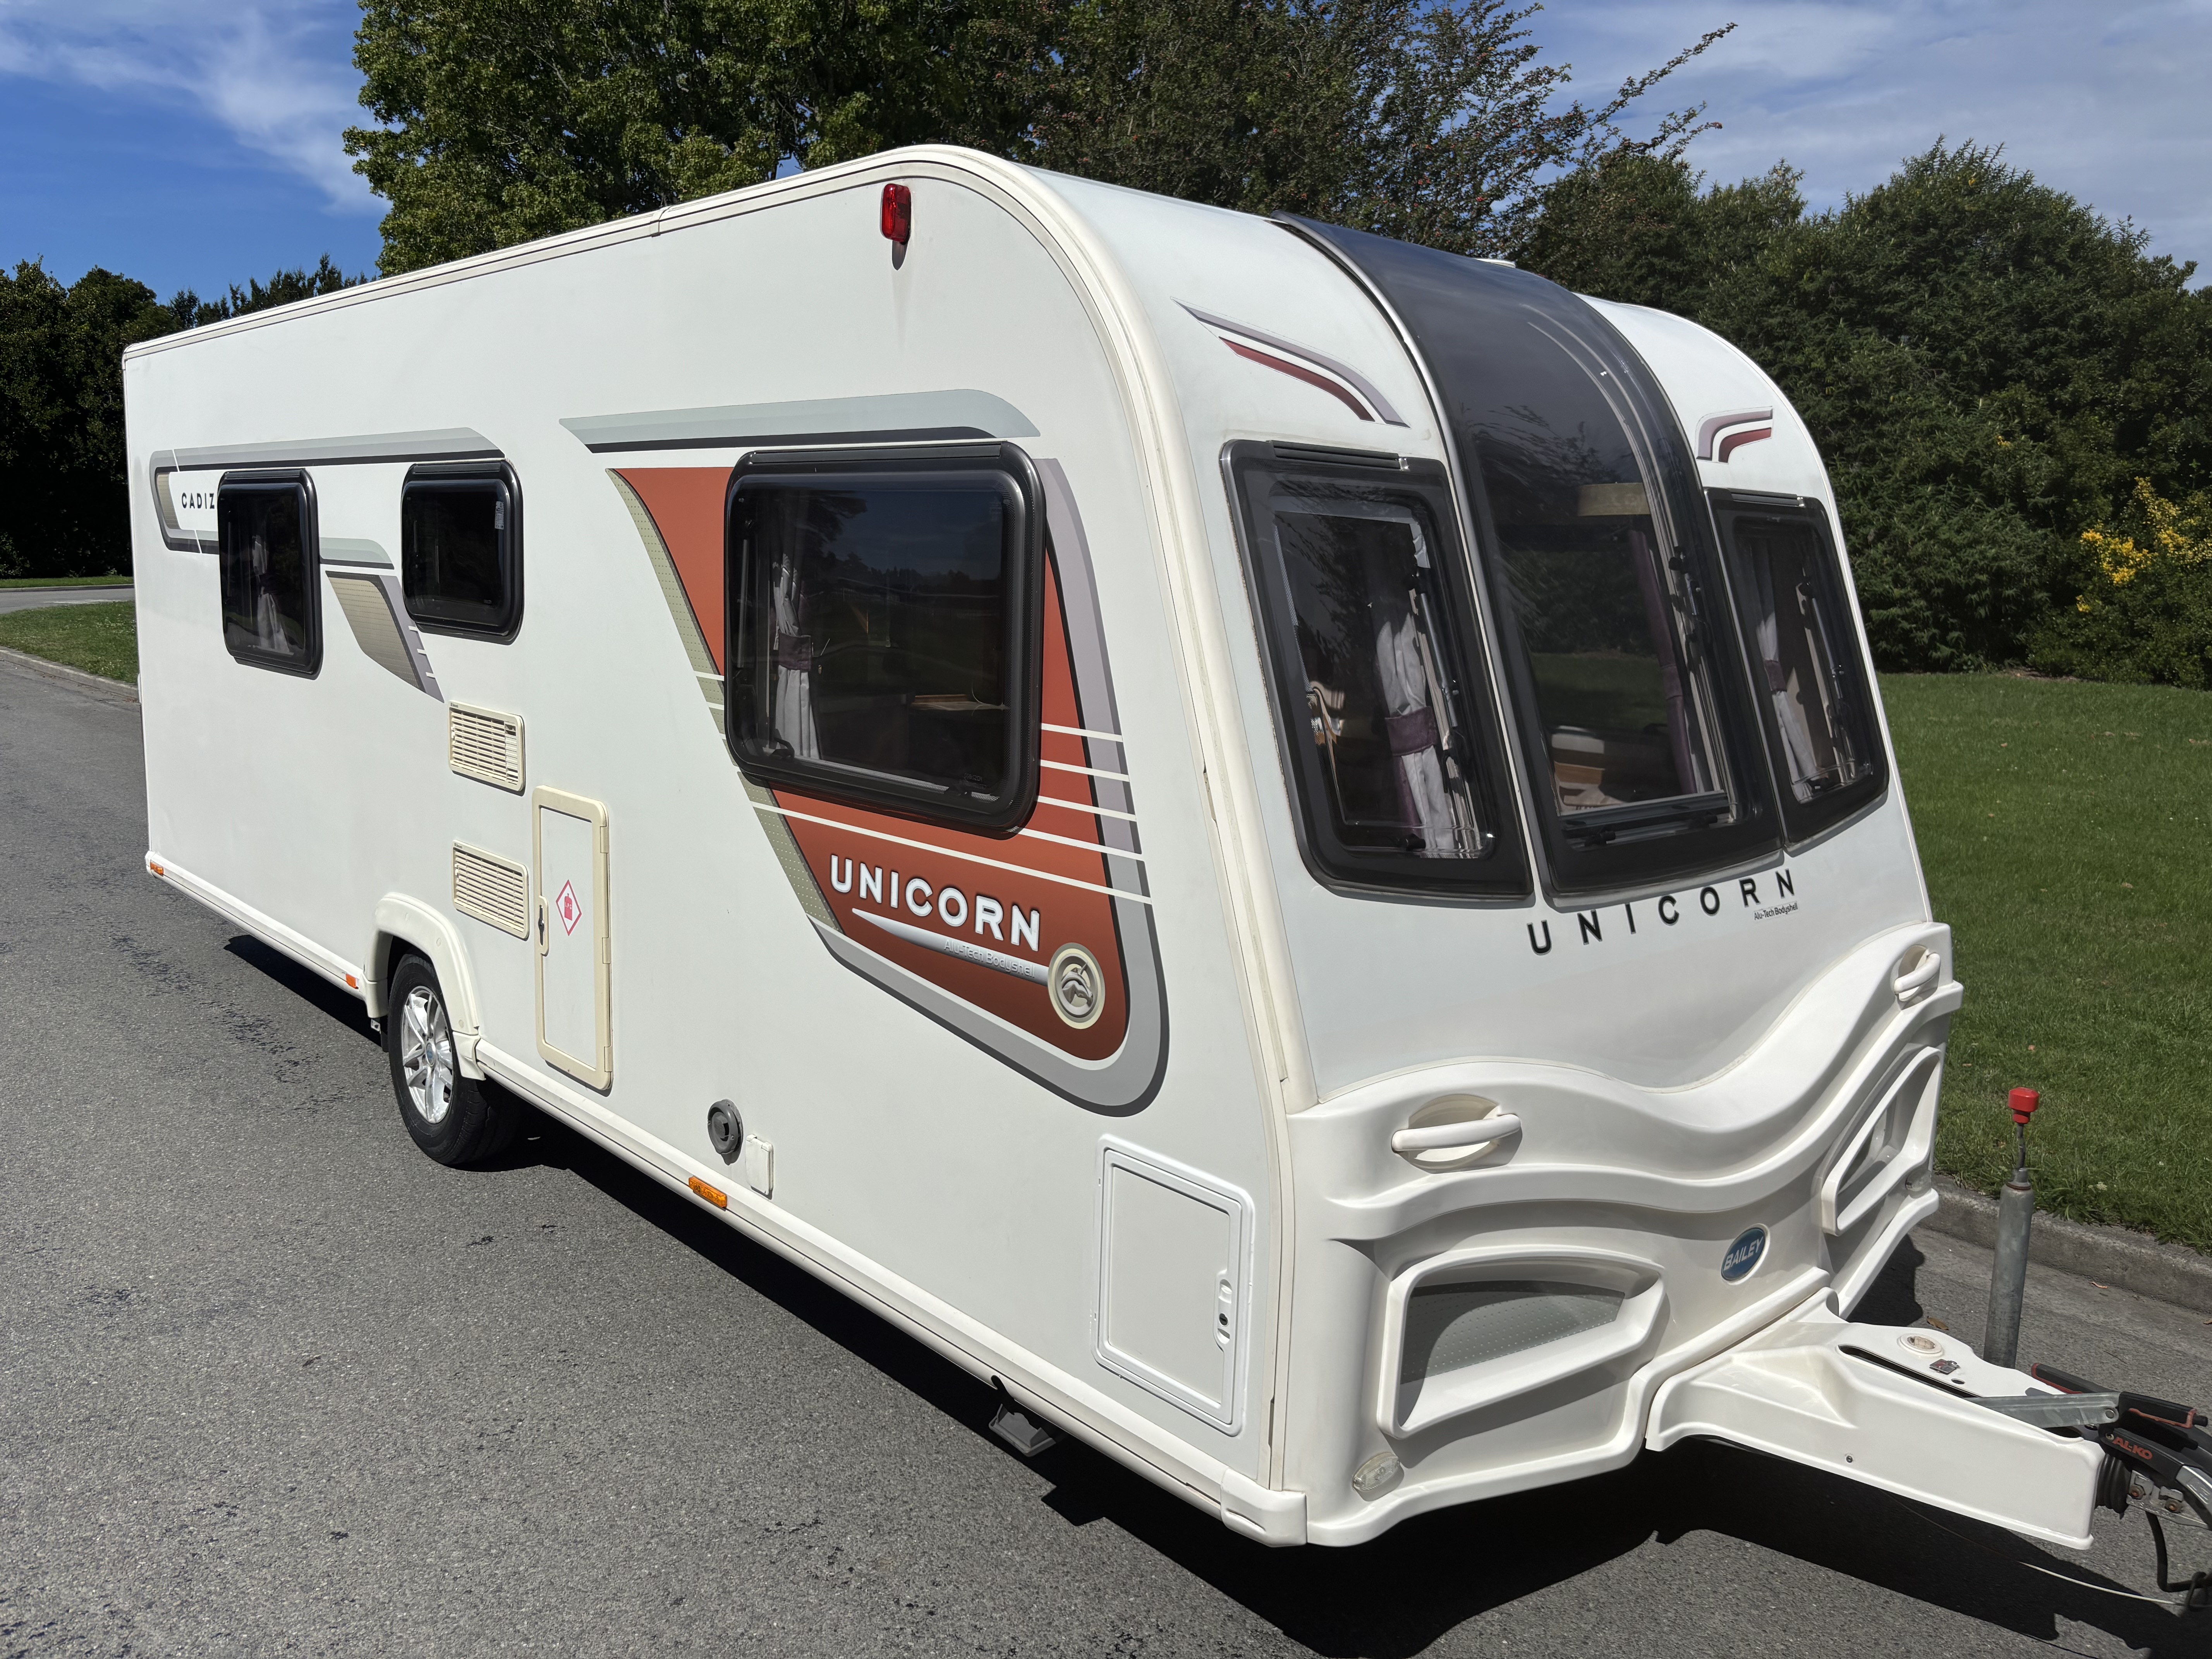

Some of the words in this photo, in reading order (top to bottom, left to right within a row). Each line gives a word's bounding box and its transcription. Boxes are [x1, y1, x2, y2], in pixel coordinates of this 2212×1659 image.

[182, 492, 215, 509] CADIZ
[830, 854, 1041, 951] UNICORN
[1527, 868, 1794, 955] UNICORN
[1755, 908, 1775, 920] Alu-Tech
[1774, 902, 1798, 915] Bodyshell
[944, 939, 984, 962] Alu-Tech
[986, 951, 1036, 978] Bodyshell
[1724, 1236, 1764, 1271] BAILEY
[2112, 1437, 2153, 1460] AL-KO
